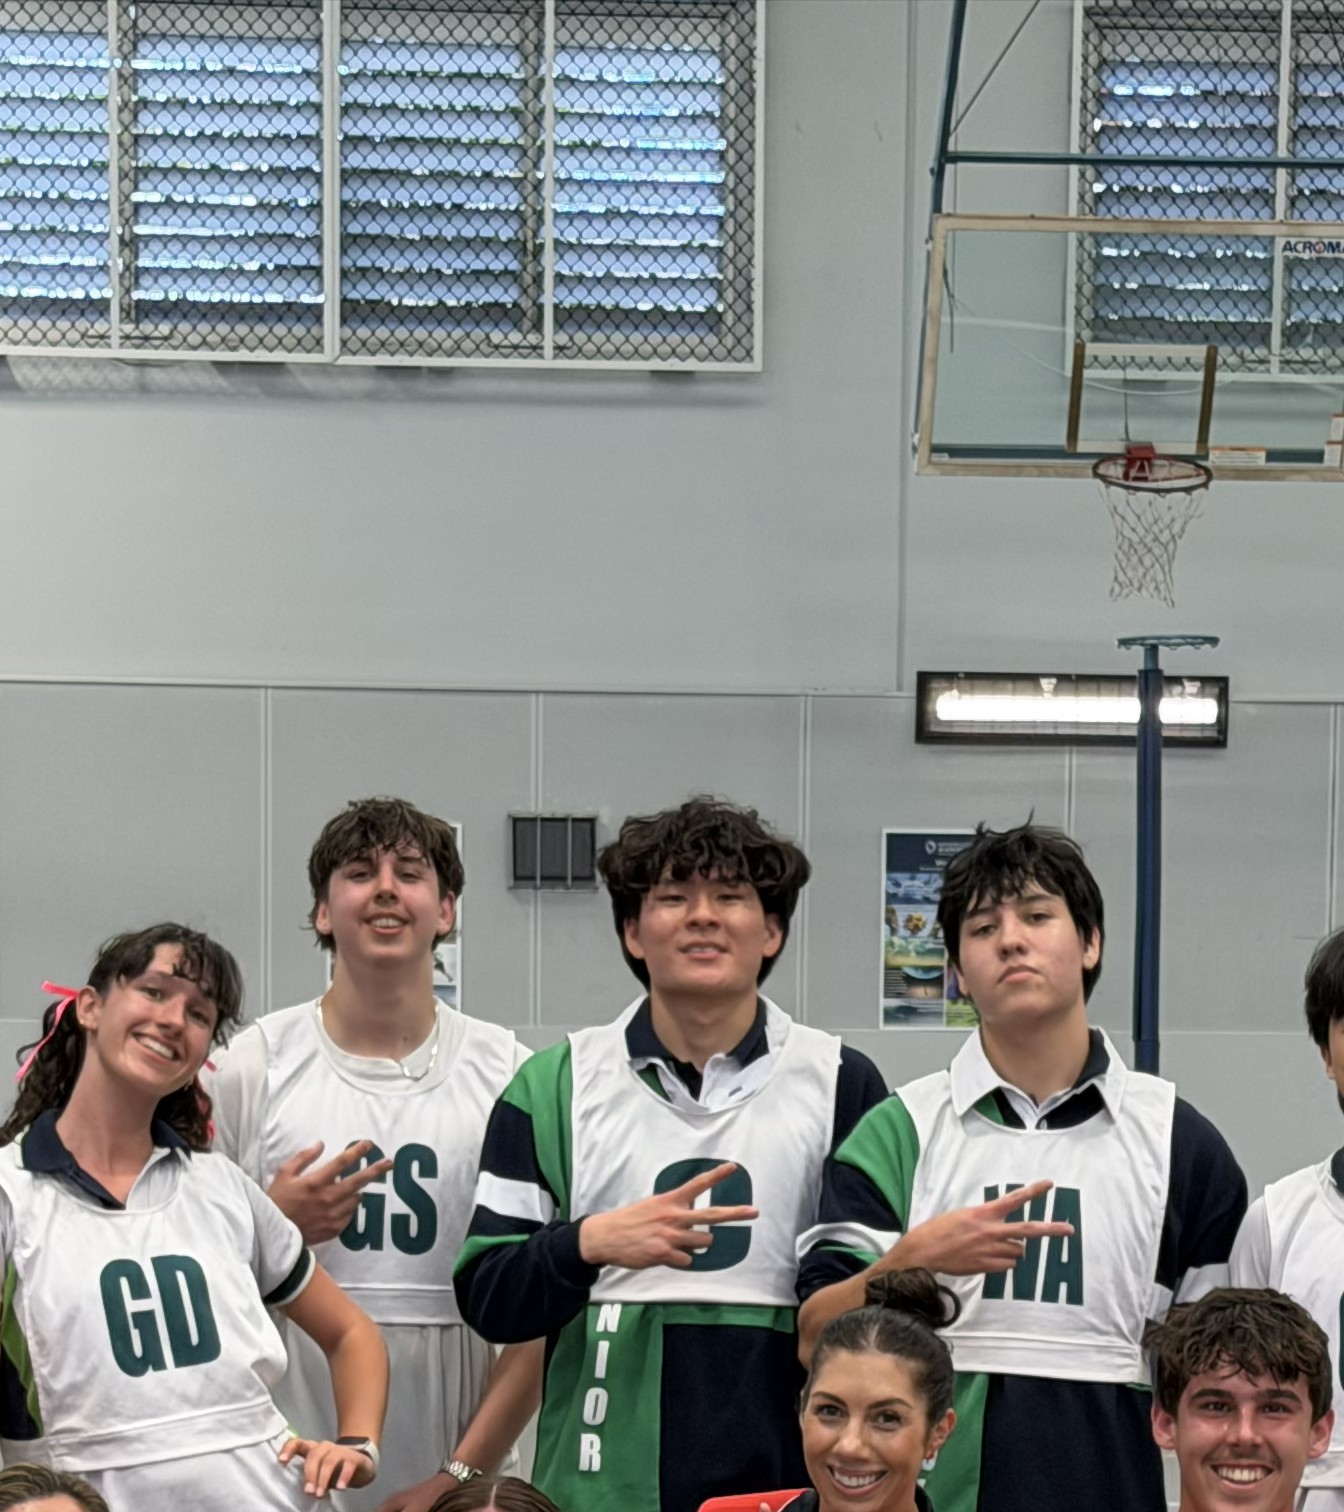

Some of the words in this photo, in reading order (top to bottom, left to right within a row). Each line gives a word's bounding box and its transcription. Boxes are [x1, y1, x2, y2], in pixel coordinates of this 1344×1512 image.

[338, 1139, 438, 1255] GS
[981, 1183, 1084, 1307] WA
[99, 1253, 223, 1378] GD
